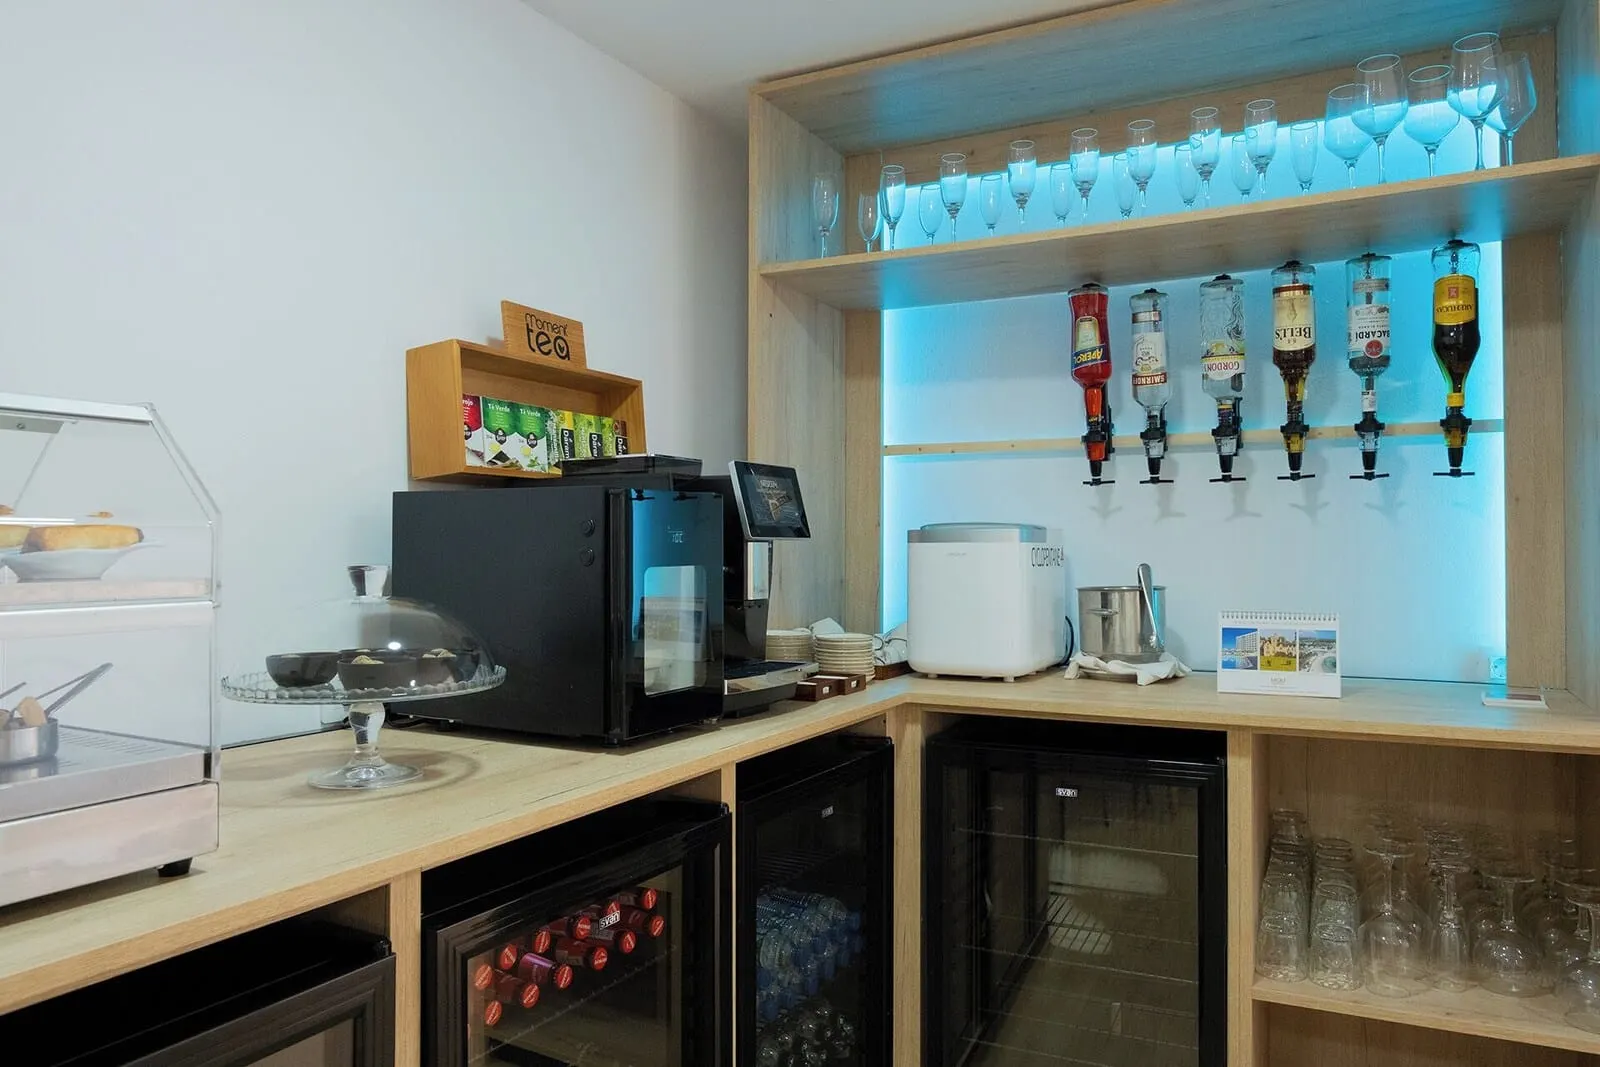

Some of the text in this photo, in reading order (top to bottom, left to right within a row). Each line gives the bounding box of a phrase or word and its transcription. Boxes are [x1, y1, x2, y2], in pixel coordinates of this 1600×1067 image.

[526, 323, 571, 361] tea
[1073, 347, 1103, 366] APEROL
[600, 912, 619, 929] svan
